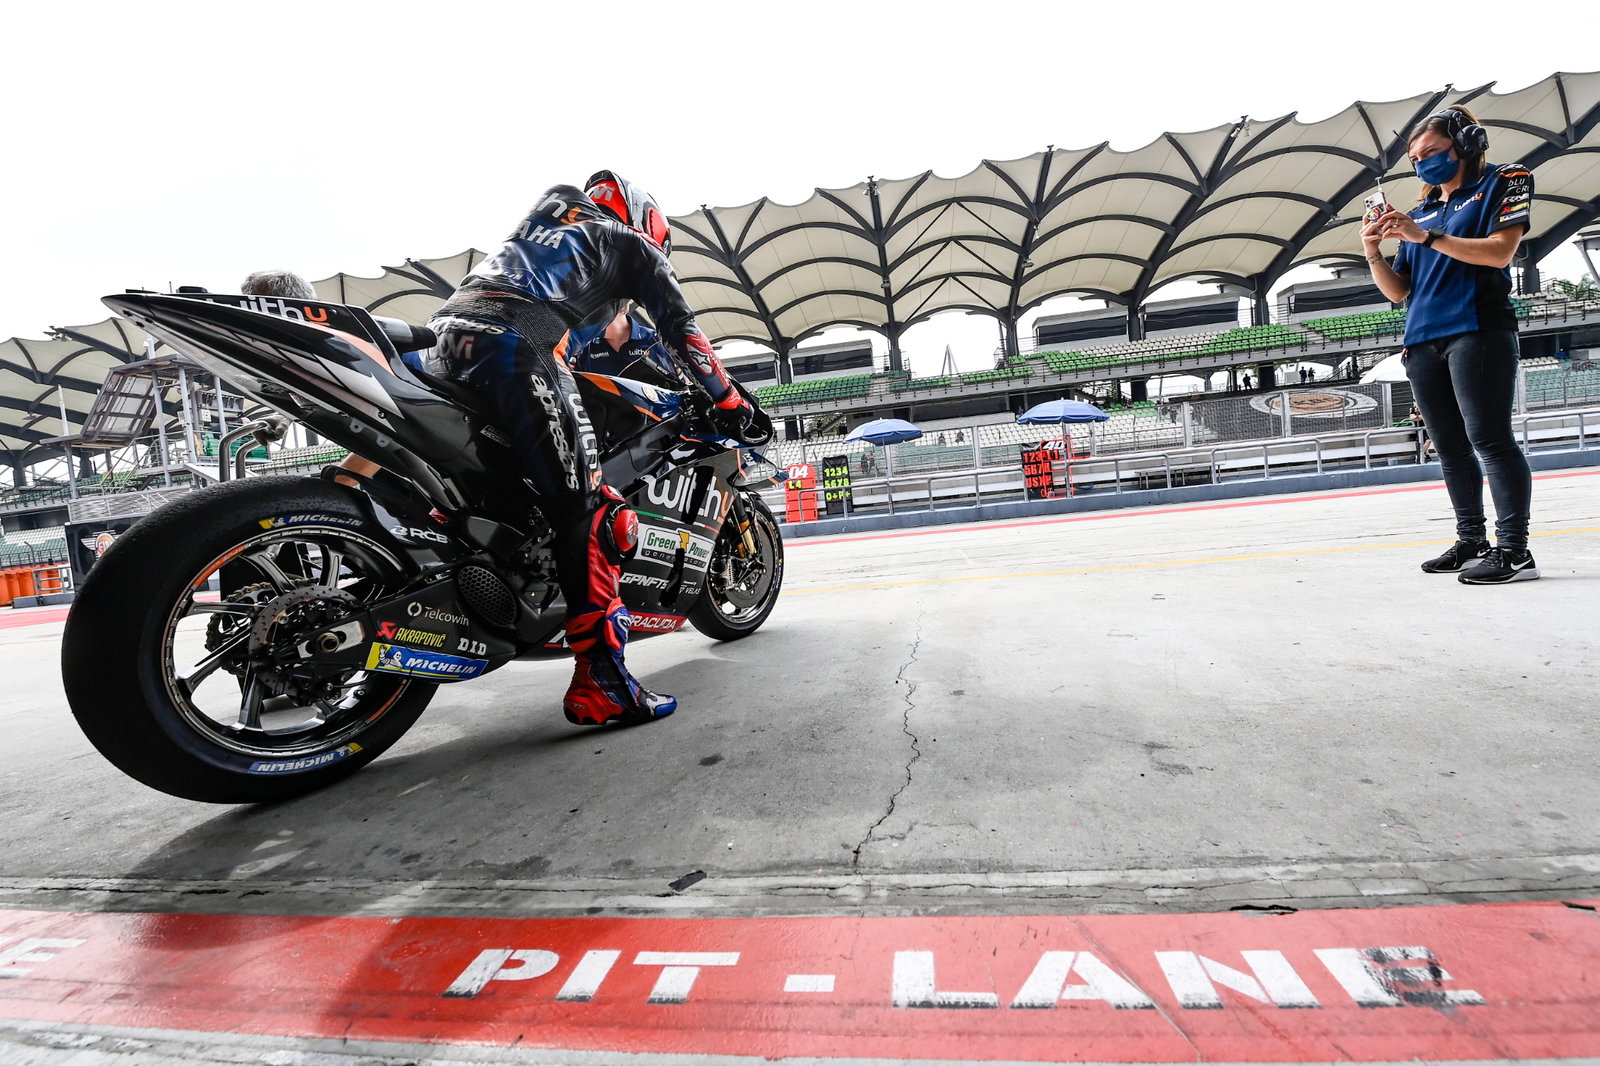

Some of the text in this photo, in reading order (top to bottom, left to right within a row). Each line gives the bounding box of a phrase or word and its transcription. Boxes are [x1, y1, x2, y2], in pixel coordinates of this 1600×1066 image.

[514, 219, 565, 250] AHA
[530, 373, 580, 491] alpinestars
[789, 465, 809, 479] 04
[824, 466, 849, 477] 1234
[290, 513, 364, 528] MICHELIN
[646, 532, 676, 551] Green
[424, 606, 470, 627] Telcowin
[630, 614, 677, 629] RACUDA
[404, 657, 477, 675] MICHELIN
[257, 752, 335, 773] MICHELIN
[440, 947, 741, 1005] PIT
[892, 945, 1486, 1009] LANE
